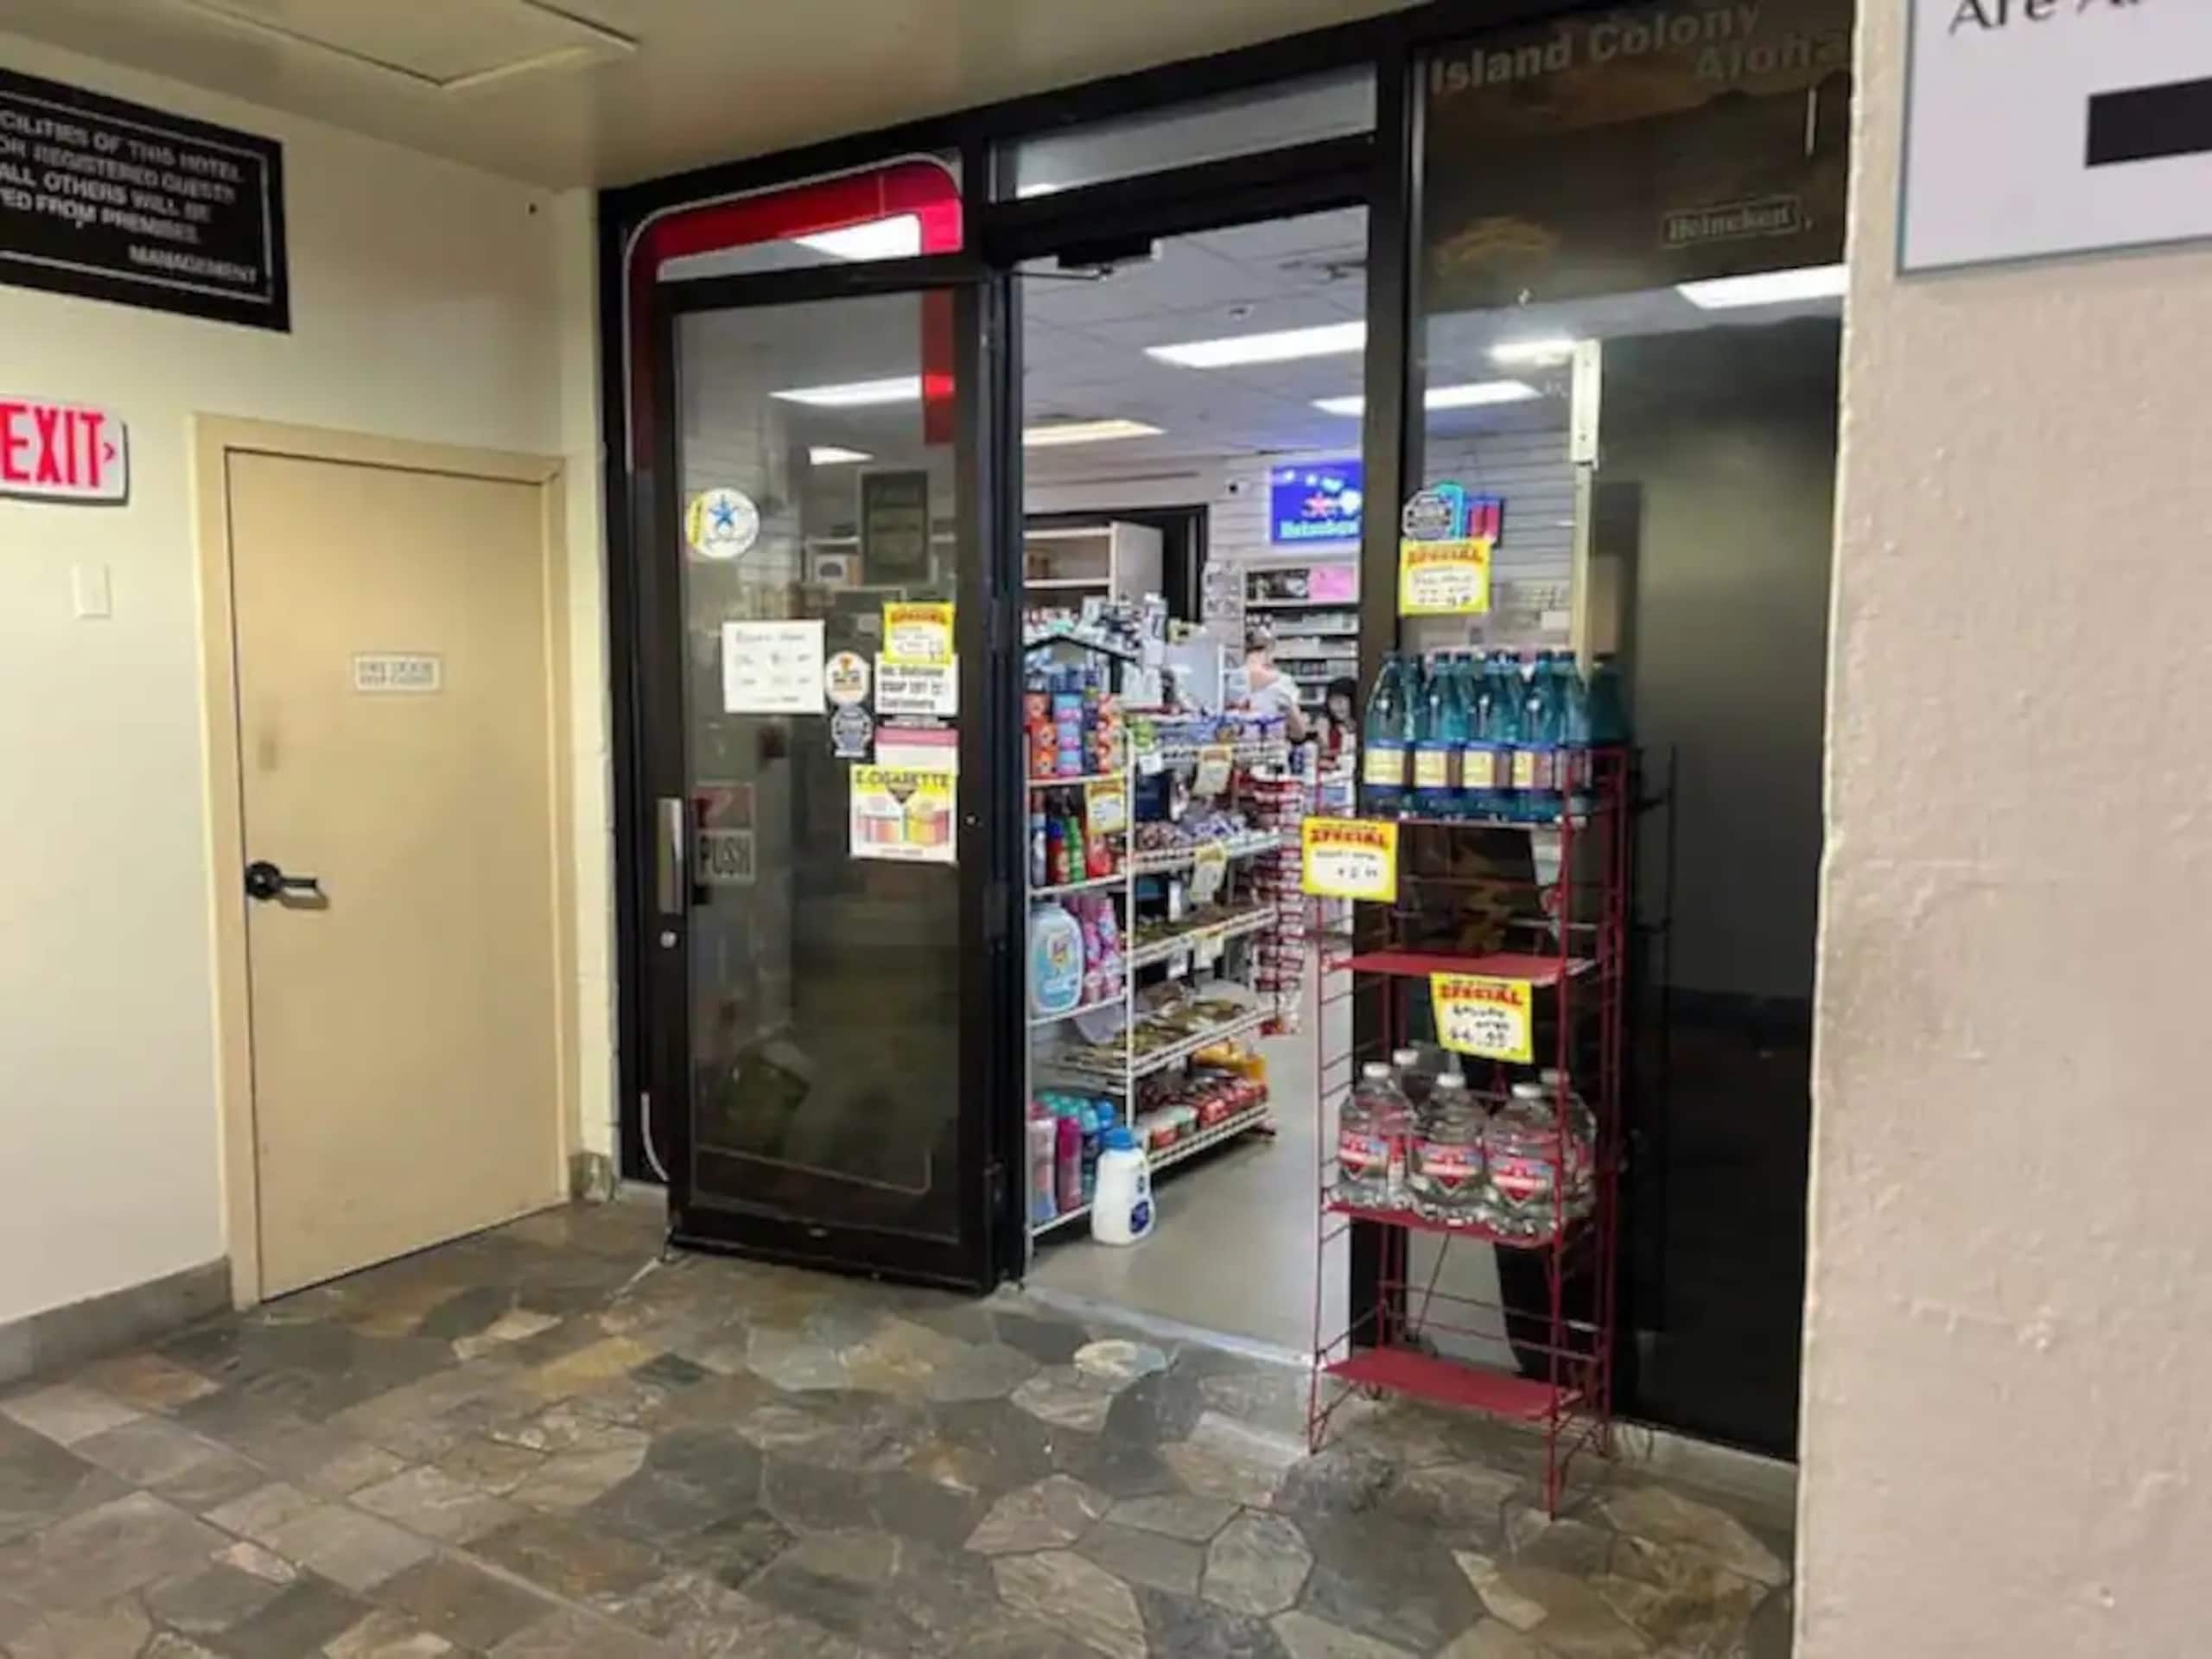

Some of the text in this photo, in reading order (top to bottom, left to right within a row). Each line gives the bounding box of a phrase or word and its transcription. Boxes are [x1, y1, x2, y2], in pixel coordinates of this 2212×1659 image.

[1430, 3, 1760, 94] Island Colony
[1696, 32, 1847, 80] Aloha
[33, 143, 158, 188] REGISTERED
[92, 131, 121, 156] OF
[129, 139, 175, 166] THIS
[43, 172, 128, 205] OTHERS
[131, 190, 180, 217] WILL
[35, 194, 97, 223] FROM
[101, 207, 200, 245] PREMISES
[1669, 205, 1789, 240] Heineken
[129, 245, 257, 284] MANAGEMENT
[0, 404, 105, 488] EXIT
[1309, 827, 1389, 850] SPECIAL
[1439, 983, 1523, 1007] SPECIAL
